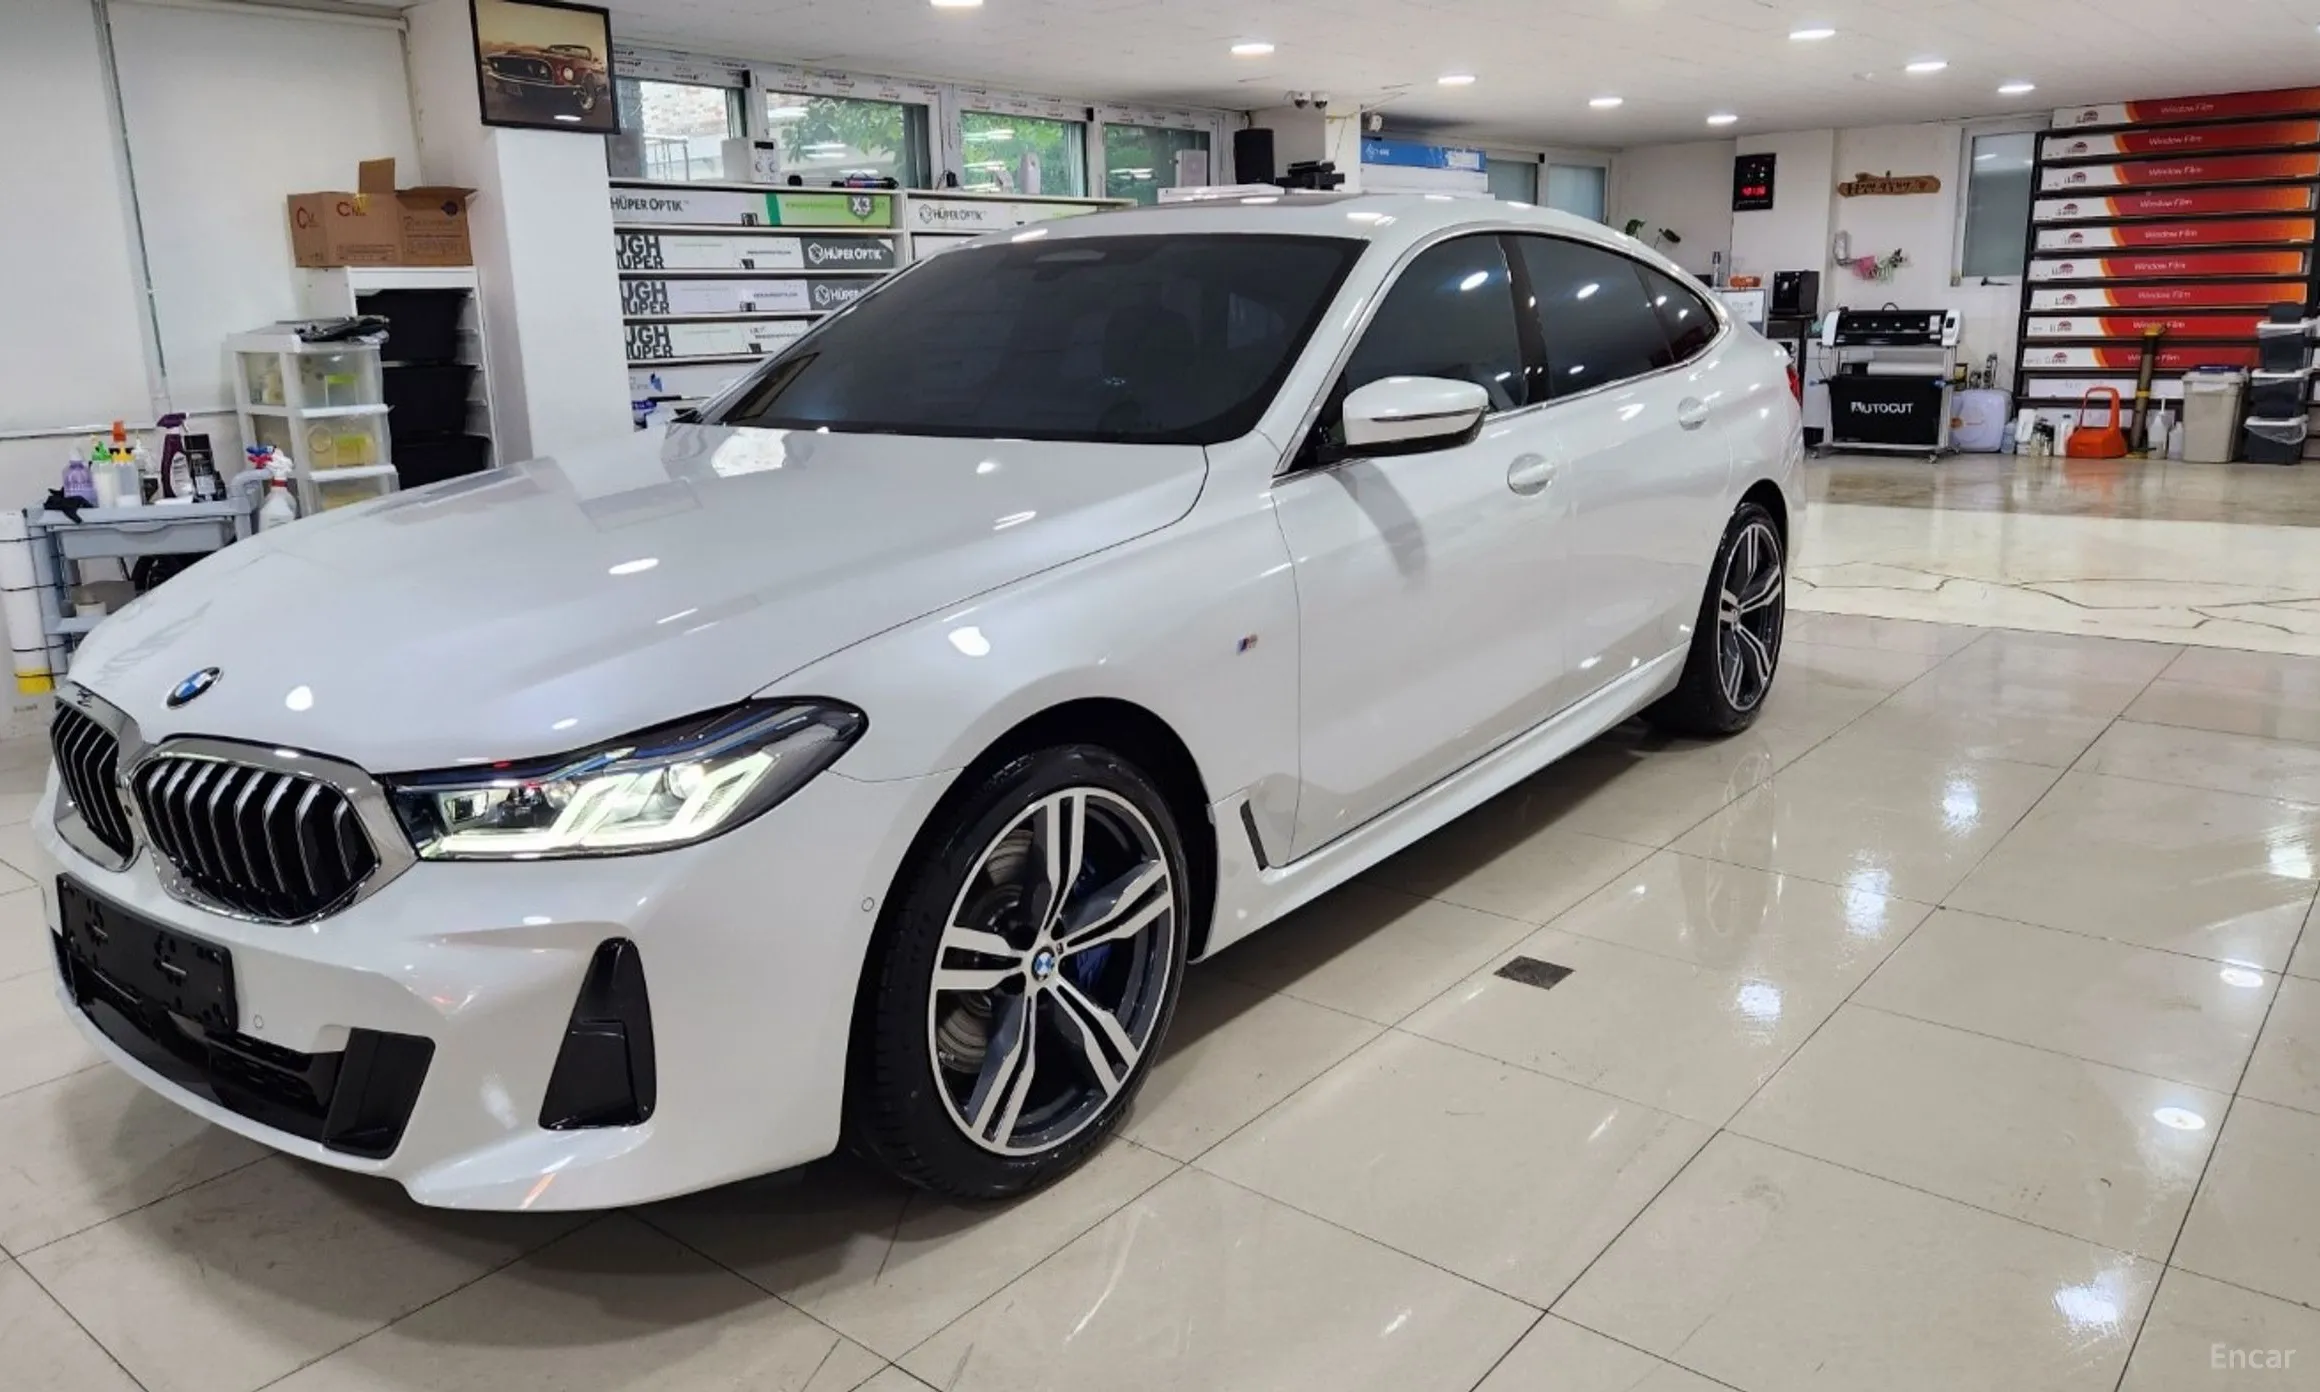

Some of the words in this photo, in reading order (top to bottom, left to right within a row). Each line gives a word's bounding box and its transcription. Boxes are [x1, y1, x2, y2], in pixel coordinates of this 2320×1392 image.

[2149, 136, 2182, 145] Window
[2184, 135, 2203, 143] Film
[2149, 167, 2182, 176] Window
[2184, 165, 2203, 174] Film
[649, 197, 684, 212] OPTIK
[1851, 402, 1914, 414] AUTOCUT
